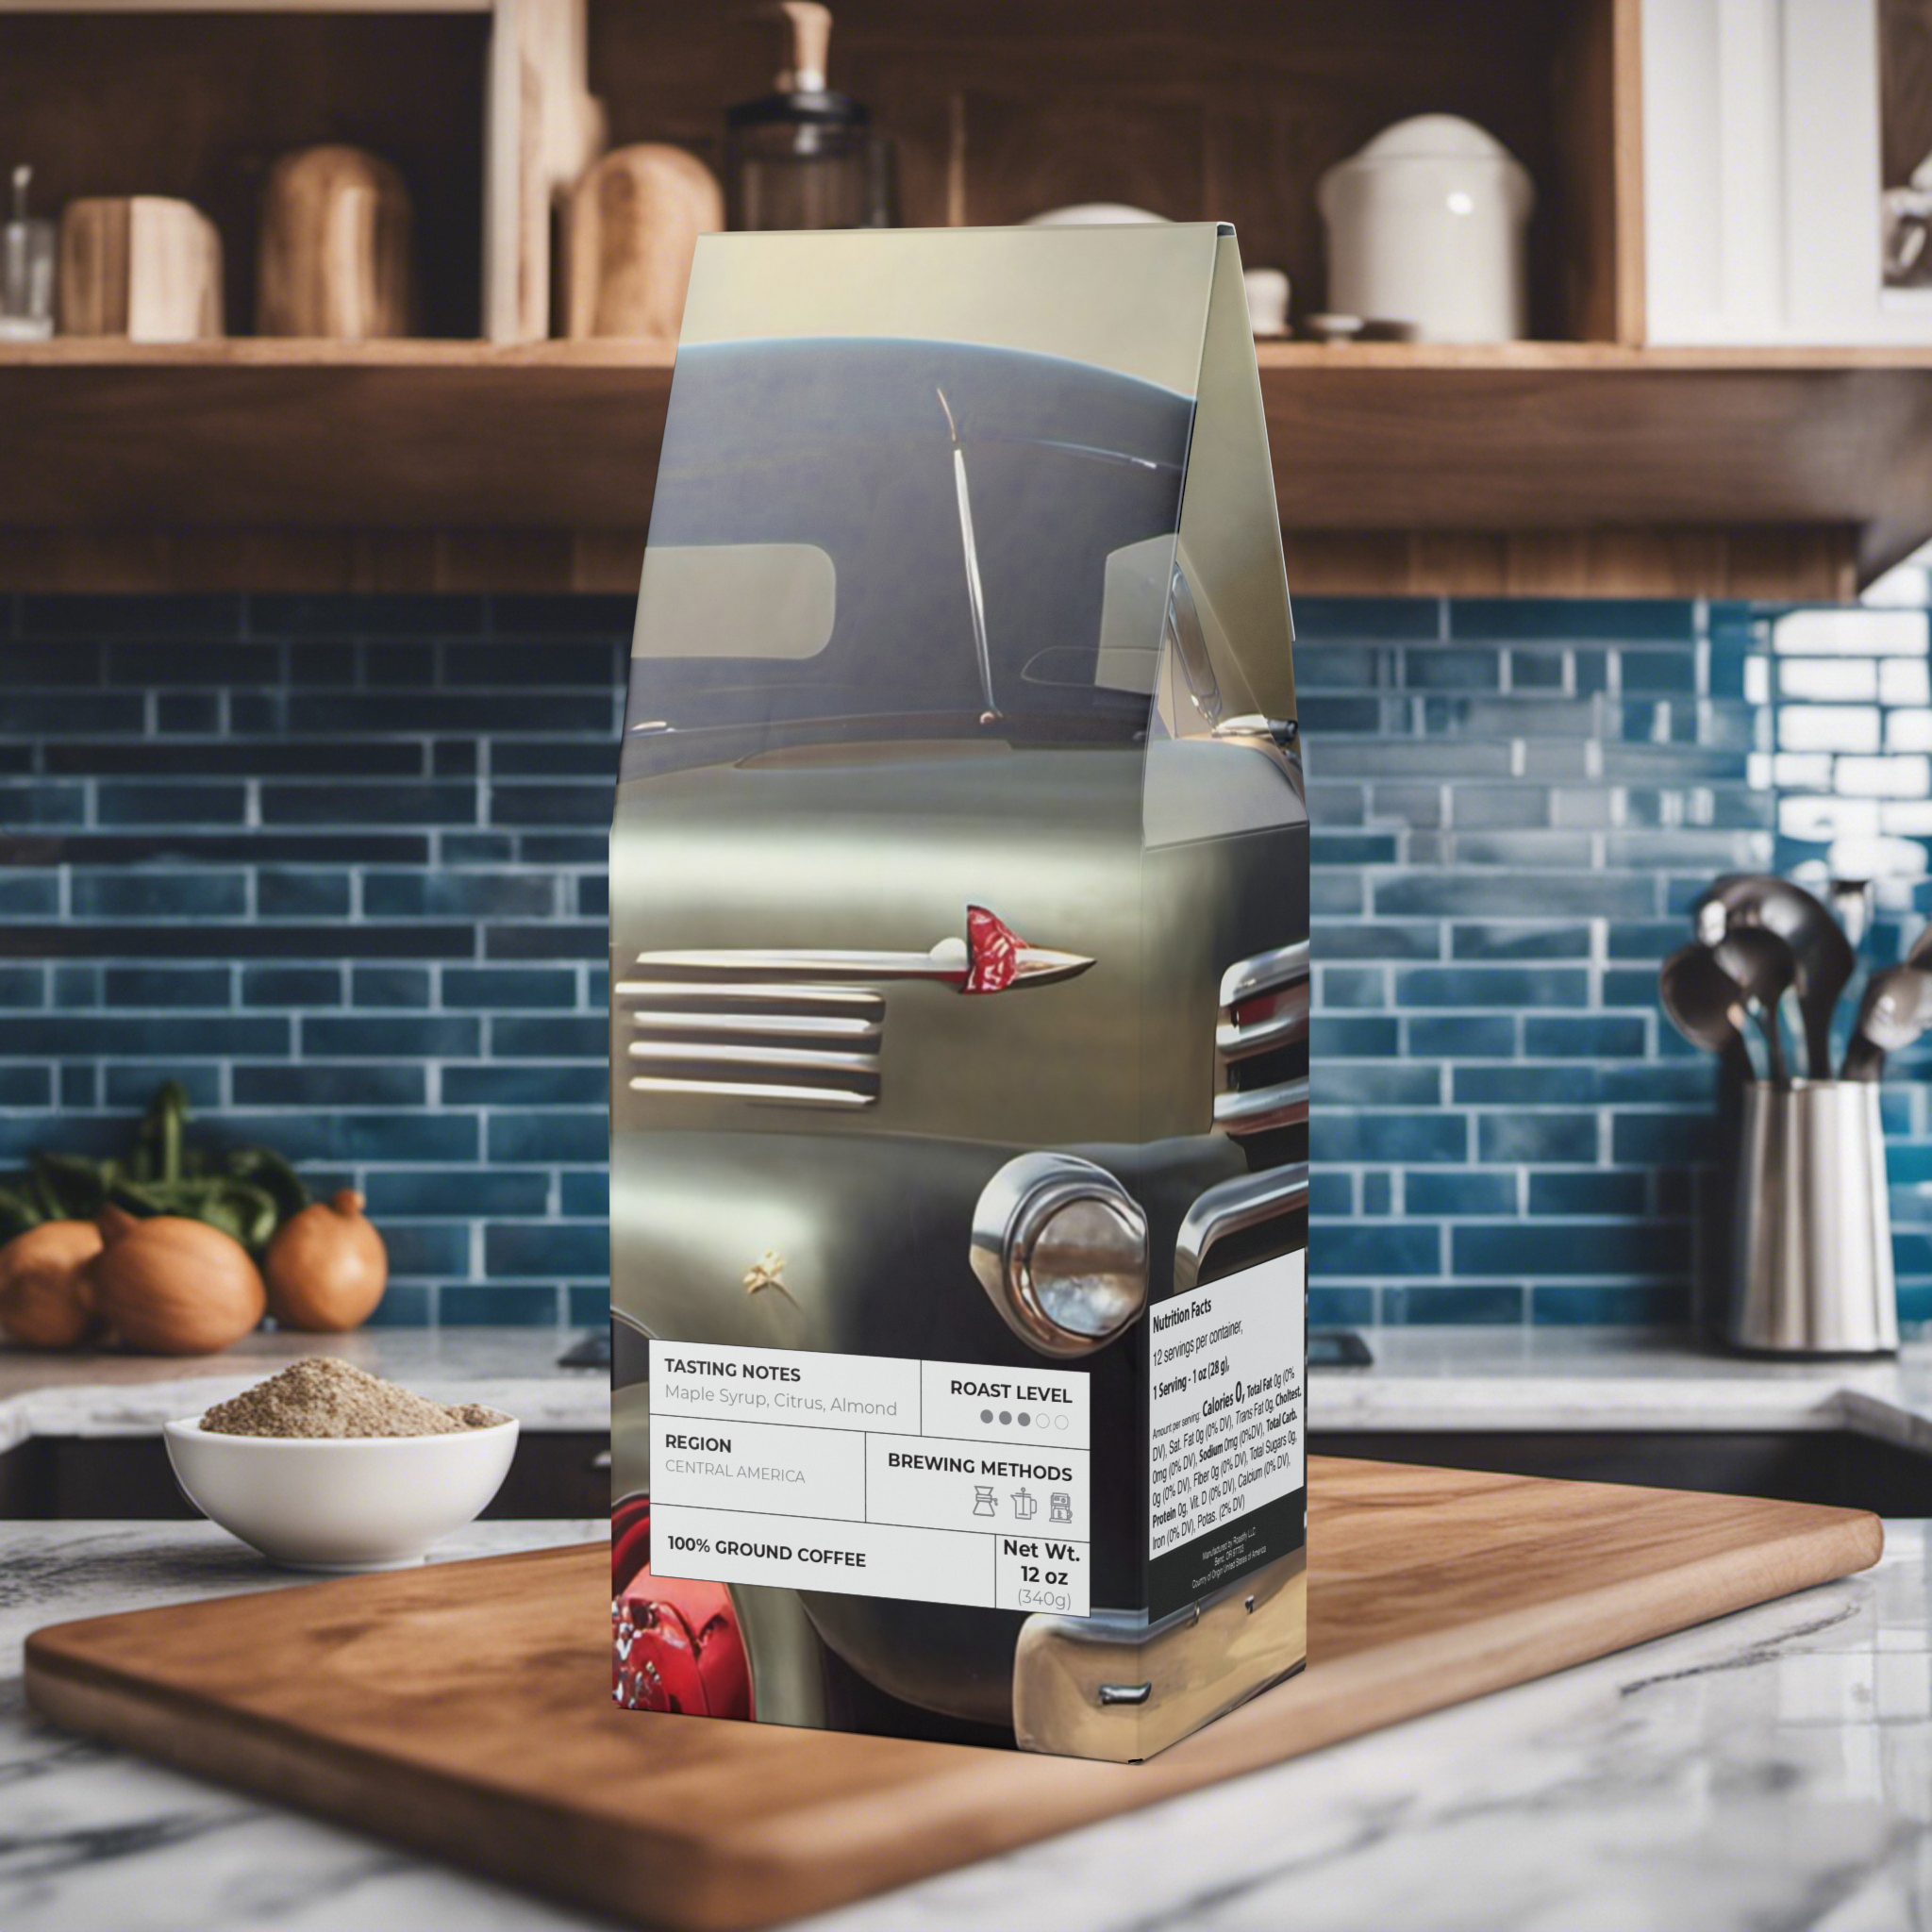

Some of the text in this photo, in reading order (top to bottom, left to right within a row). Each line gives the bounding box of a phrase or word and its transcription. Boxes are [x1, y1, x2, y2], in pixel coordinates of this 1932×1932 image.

[1153, 1298, 1211, 1333] Nutrition Facts
[1153, 1321, 1242, 1366] 12 servings per container,
[664, 1358, 801, 1382] TASTING NOTES
[1153, 1386, 1157, 1400] 1
[1158, 1376, 1187, 1398] Serving
[1192, 1369, 1196, 1383] 1
[1198, 1368, 1207, 1381] oz
[1208, 1360, 1219, 1379] (28
[666, 1384, 896, 1416] Maple Syrup, Citrus, Almond
[951, 1380, 1073, 1404] ROAST LEVEL
[1153, 1423, 1172, 1440] Amount
[1173, 1420, 1181, 1433] per
[1203, 1392, 1233, 1417] Calories
[1247, 1379, 1261, 1398] Total
[1263, 1376, 1273, 1391] Fat
[666, 1434, 731, 1453] REGION
[1170, 1438, 1181, 1454] Sat.
[1184, 1432, 1194, 1448] Fat
[1236, 1408, 1253, 1424] Trans
[1255, 1401, 1264, 1416] Fat
[1199, 1443, 1223, 1462] Sodium
[1266, 1413, 1281, 1432] Total
[1282, 1407, 1297, 1424] Carb.
[666, 1459, 805, 1483] CENTRAL AMERICA
[889, 1453, 1073, 1481] BREWING METHODS
[1193, 1471, 1209, 1487] Fiber
[1250, 1442, 1264, 1460] Total
[1266, 1435, 1287, 1454] Sugars
[1153, 1507, 1175, 1528] Protein
[1190, 1495, 1200, 1509] Vit.
[1202, 1491, 1207, 1505] D
[1238, 1468, 1262, 1488] Calcium
[1153, 1535, 1165, 1550] Iron
[1198, 1511, 1217, 1528] Potas.
[1219, 1501, 1231, 1522] (2%
[1233, 1494, 1244, 1511] DV)
[668, 1536, 866, 1567] 100% GROUND COFFEE
[1004, 1539, 1080, 1562] Net Wt.
[1021, 1565, 1068, 1585] 12 oz
[1018, 1589, 1071, 1610] (340g)
